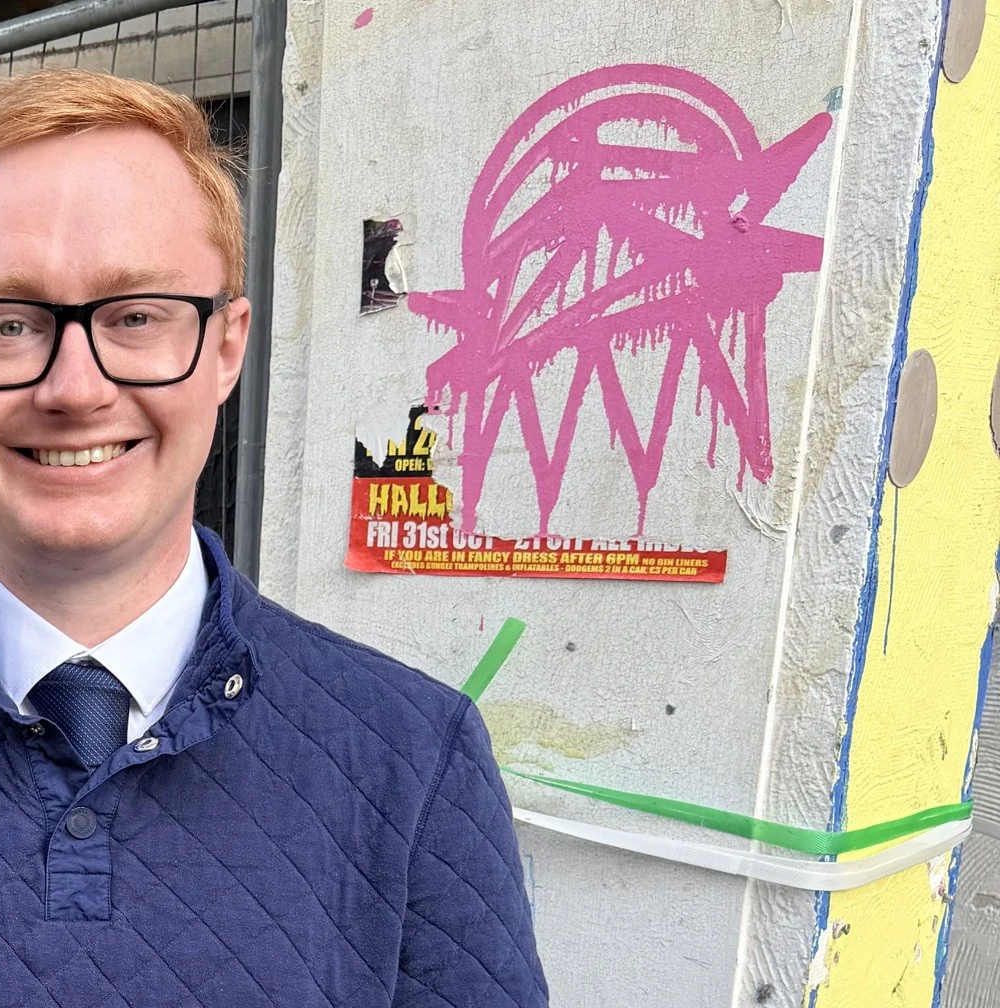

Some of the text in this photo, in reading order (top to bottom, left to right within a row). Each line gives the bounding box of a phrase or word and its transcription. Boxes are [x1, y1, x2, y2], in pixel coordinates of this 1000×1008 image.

[394, 458, 426, 472] OPEN:
[366, 521, 399, 548] FRI
[402, 521, 449, 549] 31st
[384, 550, 709, 568] IF YOU ARE IN FANCY DRESS AFTER 6PM NO BIN LINERS
[454, 562, 505, 571] TRAMPOLINES
[512, 564, 560, 572] INFLATABLES
[565, 565, 604, 573] DODGEMS
[604, 565, 611, 573] 2
[661, 567, 679, 575] PER
[679, 567, 698, 576] CAR
